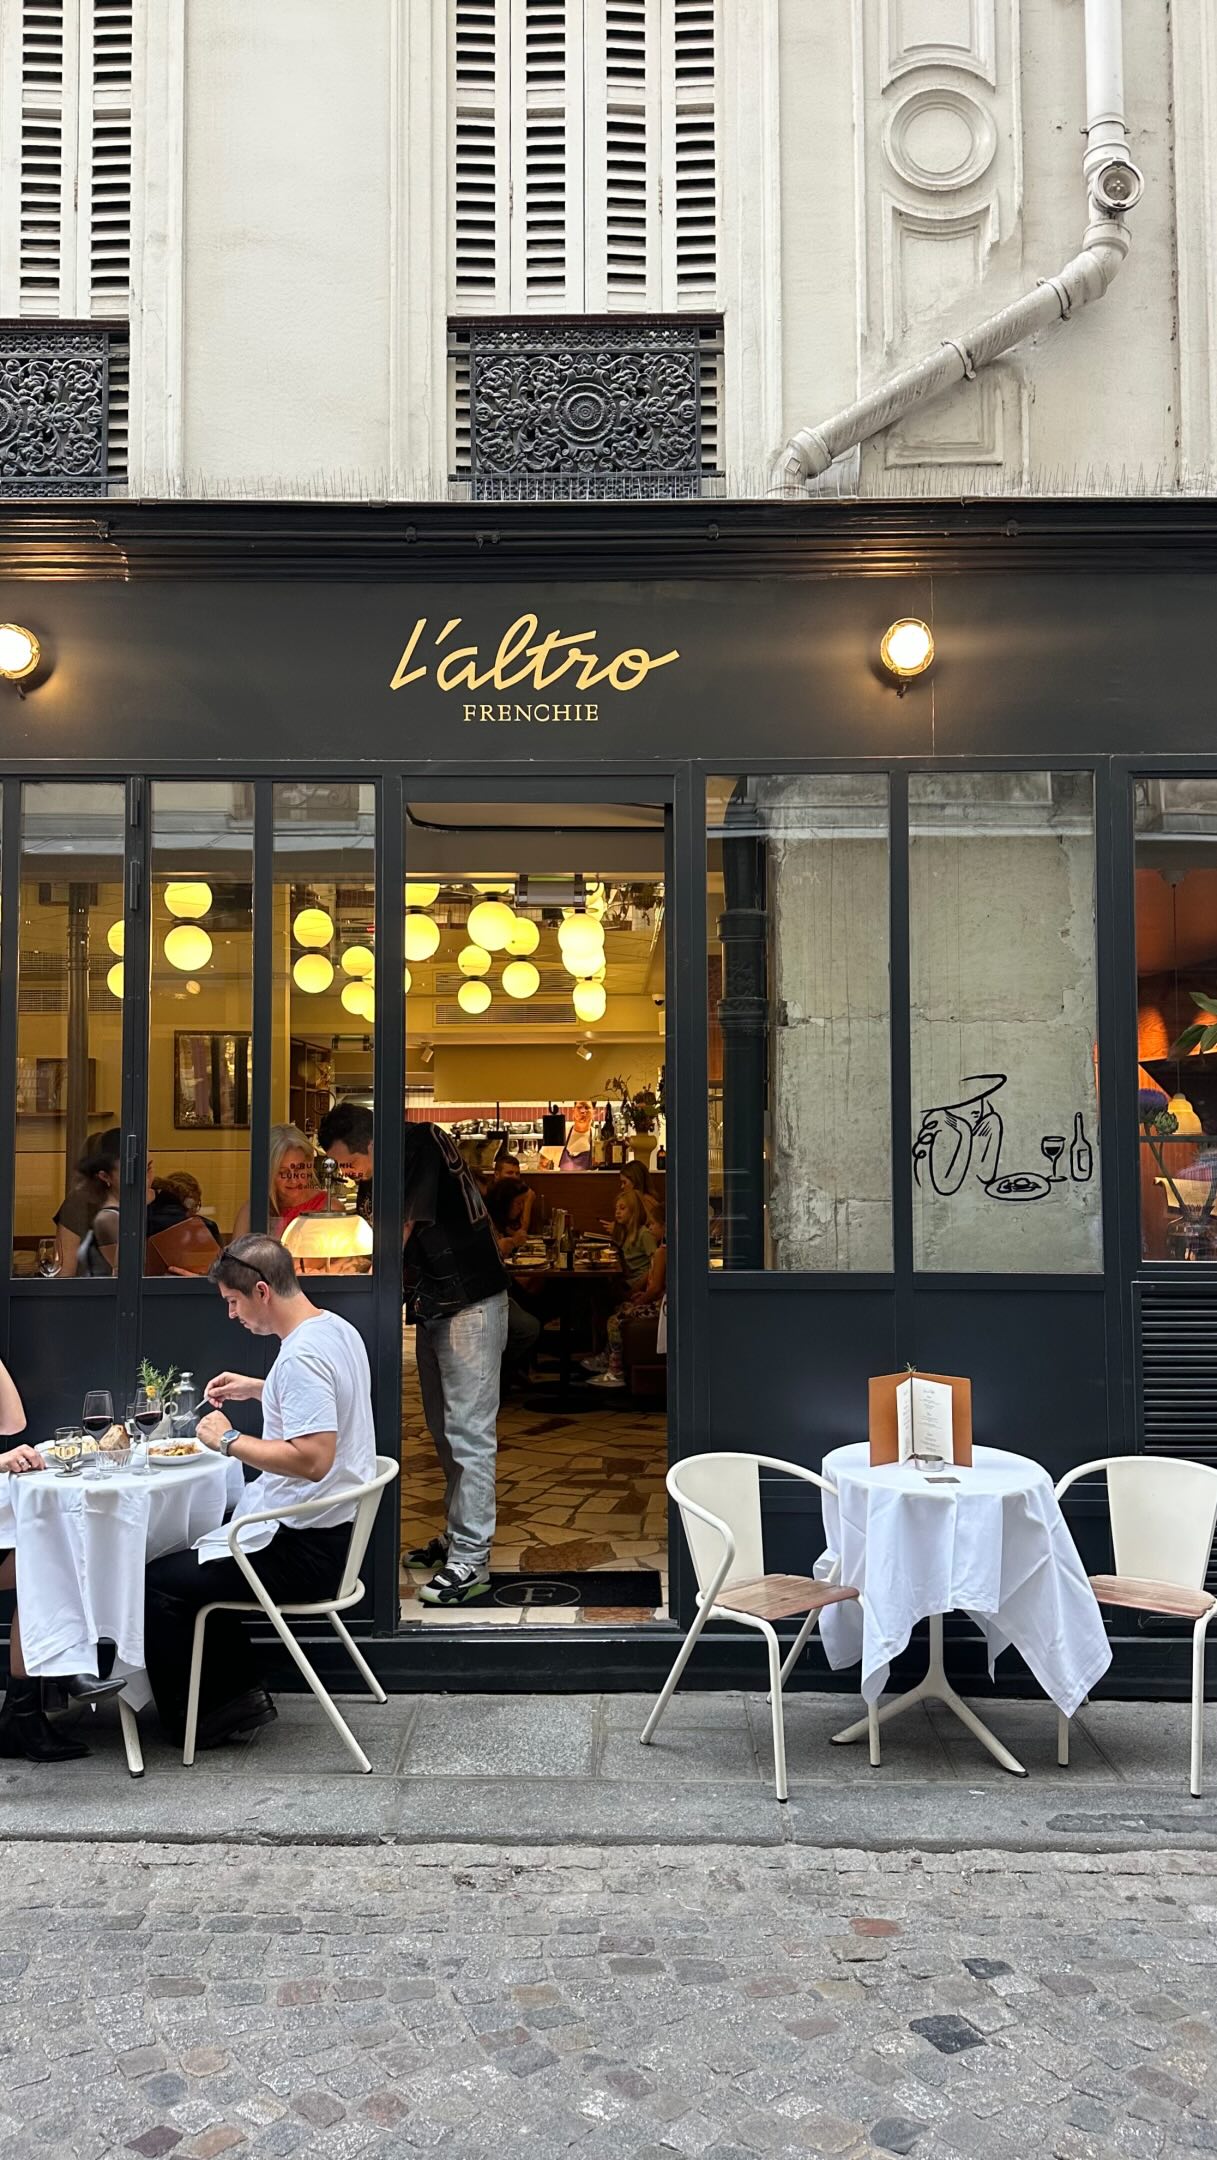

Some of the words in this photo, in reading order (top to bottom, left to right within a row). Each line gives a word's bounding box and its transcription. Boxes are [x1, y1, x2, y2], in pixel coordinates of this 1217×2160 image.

[389, 613, 680, 691] L'altro
[463, 704, 599, 722] FRENCHIE
[281, 1172, 313, 1180] LUNCH
[519, 1587, 557, 1604] F
